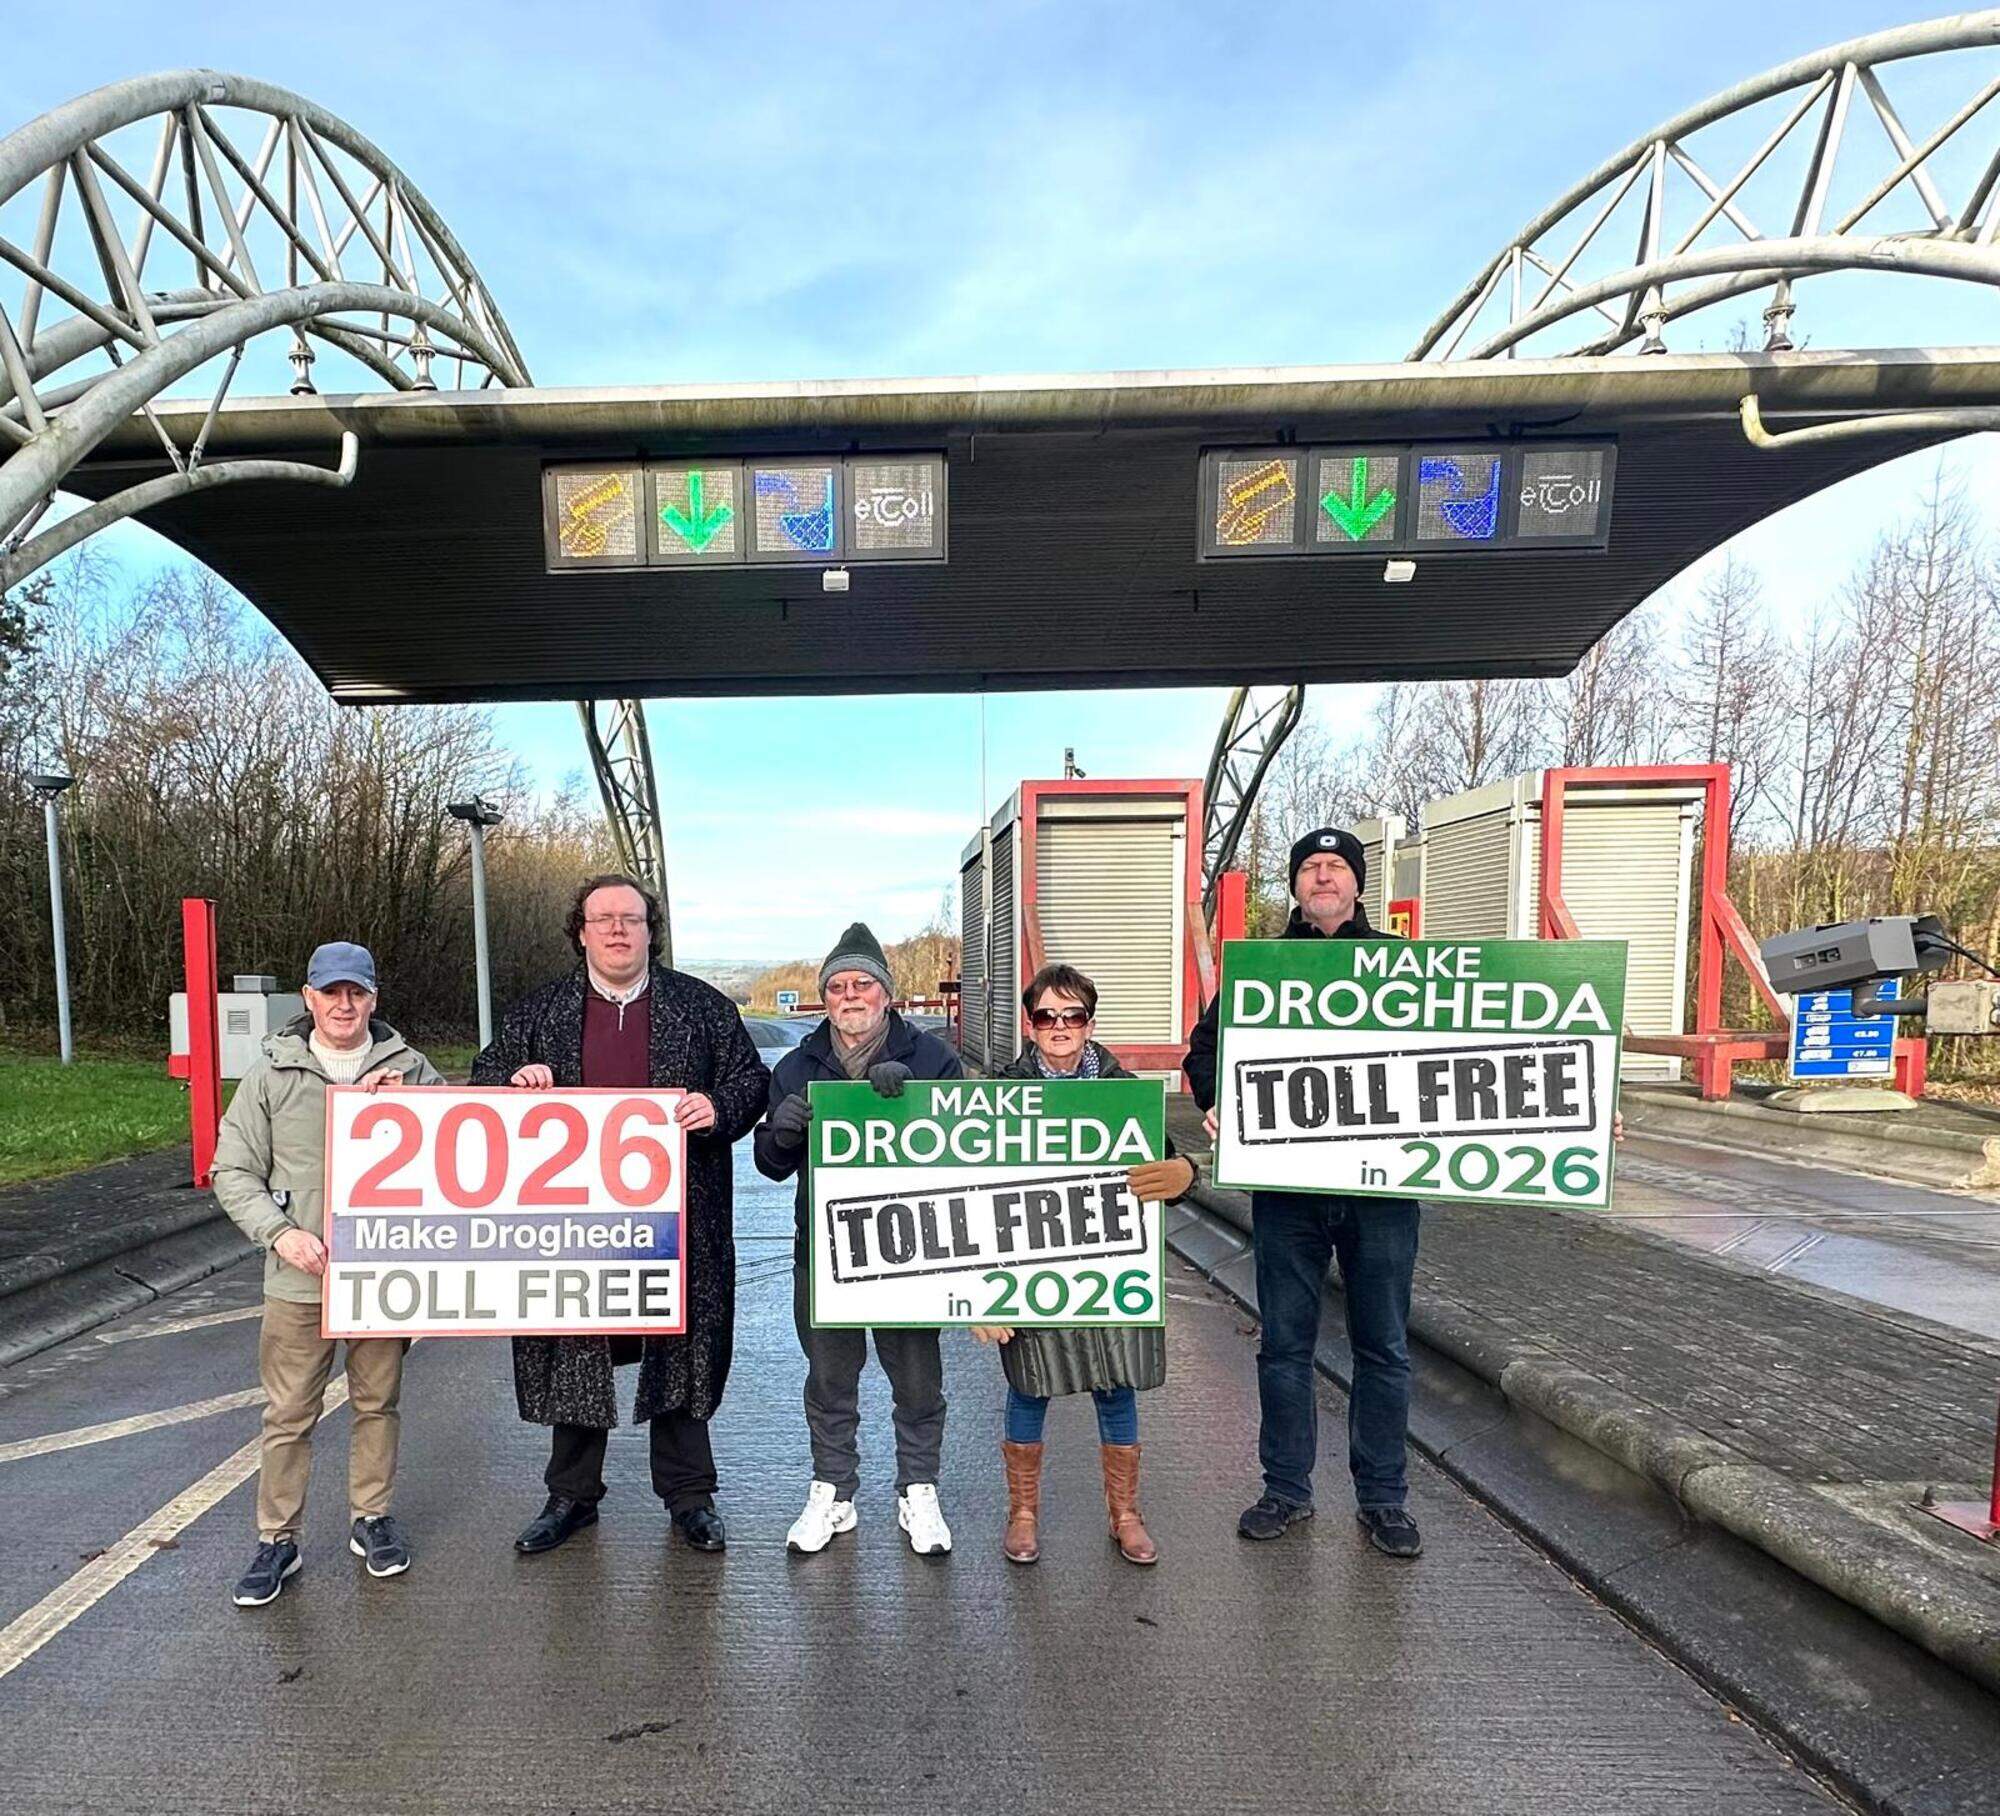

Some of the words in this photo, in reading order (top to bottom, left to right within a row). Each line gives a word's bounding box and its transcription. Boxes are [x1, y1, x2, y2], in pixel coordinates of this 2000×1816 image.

[1353, 946, 1482, 979] MAKE
[1232, 979, 1612, 1032] DROGHEDA
[930, 1086, 1043, 1117] MAKE
[1246, 1063, 1400, 1131] TOLL
[1417, 1051, 1580, 1123] FREE
[348, 1097, 672, 1209] 2026
[821, 1117, 1156, 1165] DROGHEDA
[1360, 1160, 1388, 1186] in
[1399, 1140, 1601, 1197] 2026
[355, 1218, 458, 1250] Make
[469, 1216, 655, 1257] Drogheda
[837, 1197, 981, 1268] TOLL
[992, 1182, 1134, 1253] FREE
[339, 1269, 497, 1321] TOLL
[517, 1268, 672, 1319] FREE
[948, 1293, 972, 1317] in
[982, 1269, 1154, 1317] 2026
